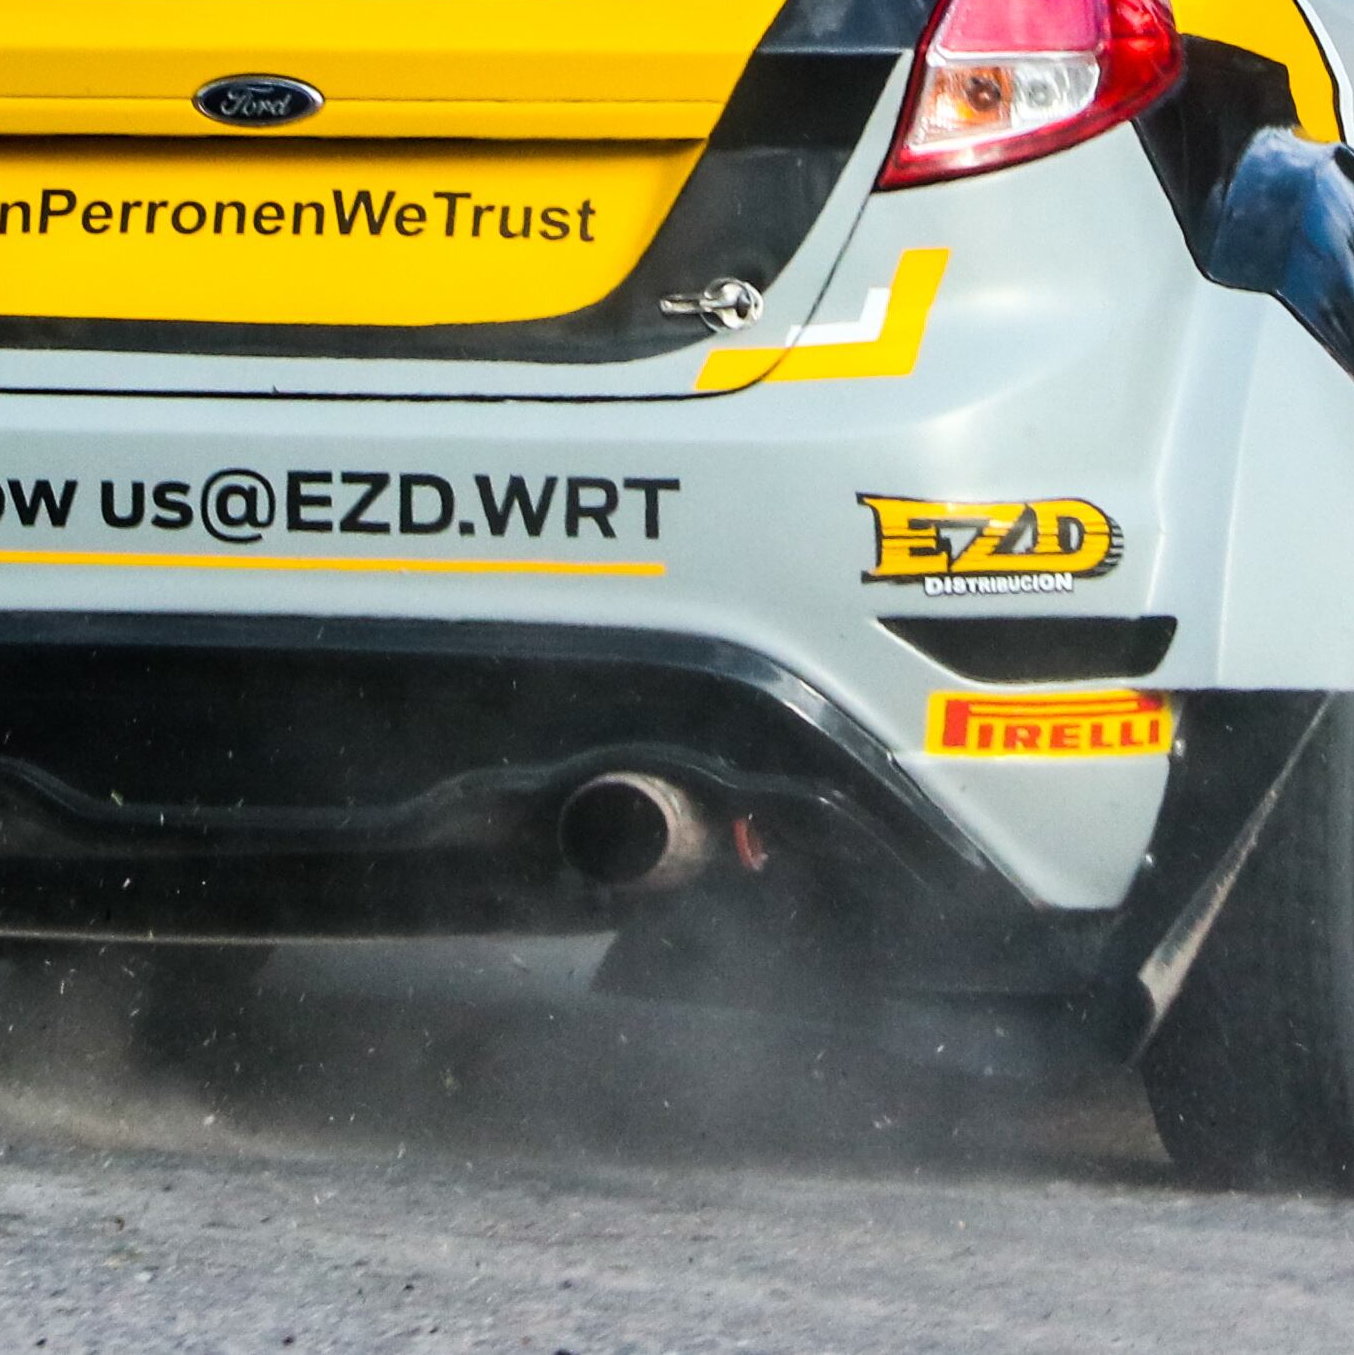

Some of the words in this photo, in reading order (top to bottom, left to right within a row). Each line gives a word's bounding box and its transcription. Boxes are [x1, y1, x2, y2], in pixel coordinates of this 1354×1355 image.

[220, 85, 292, 117] Ford
[100, 466, 681, 545] us@EZD.WRT
[856, 492, 1113, 584] EZD
[924, 572, 1074, 596] DISTRIBUCION
[942, 698, 1164, 751] PIRELLI
